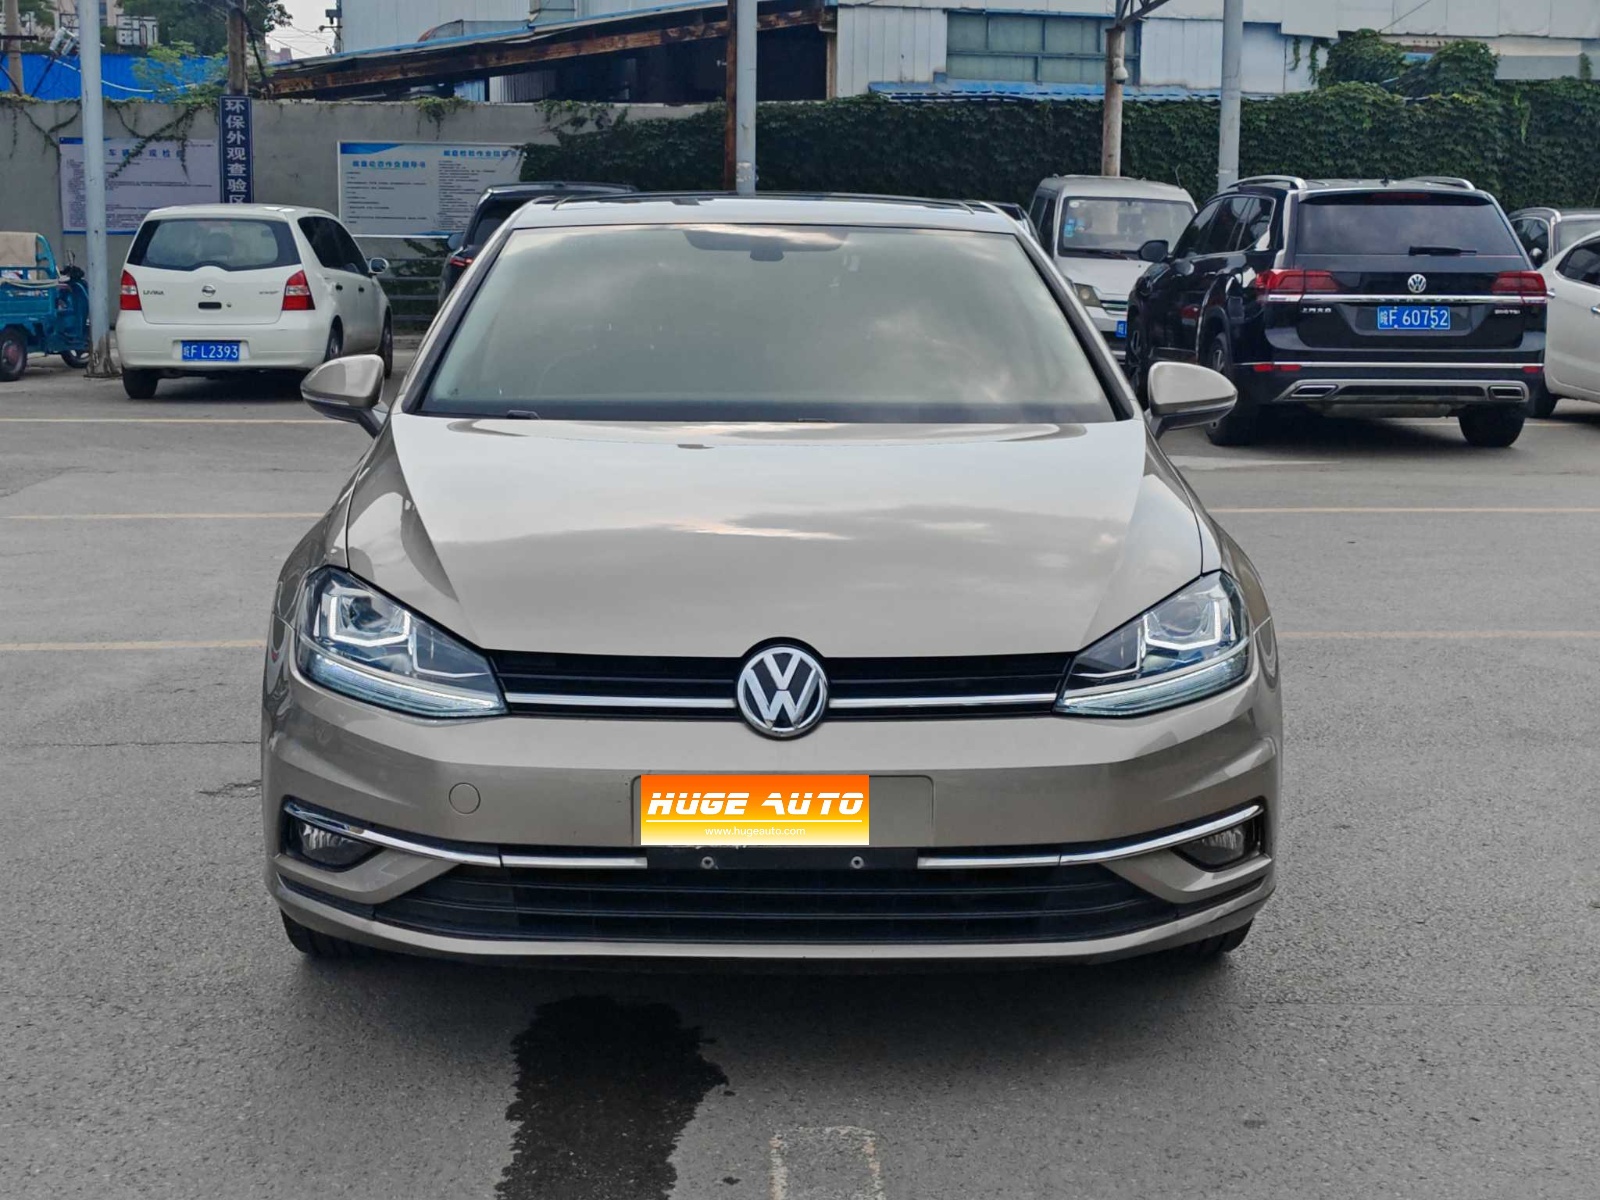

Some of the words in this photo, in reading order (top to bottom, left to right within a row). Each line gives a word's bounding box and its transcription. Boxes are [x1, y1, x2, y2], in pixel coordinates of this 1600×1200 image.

[225, 99, 247, 204] 环保外观查验区
[1402, 309, 1448, 326] 60752
